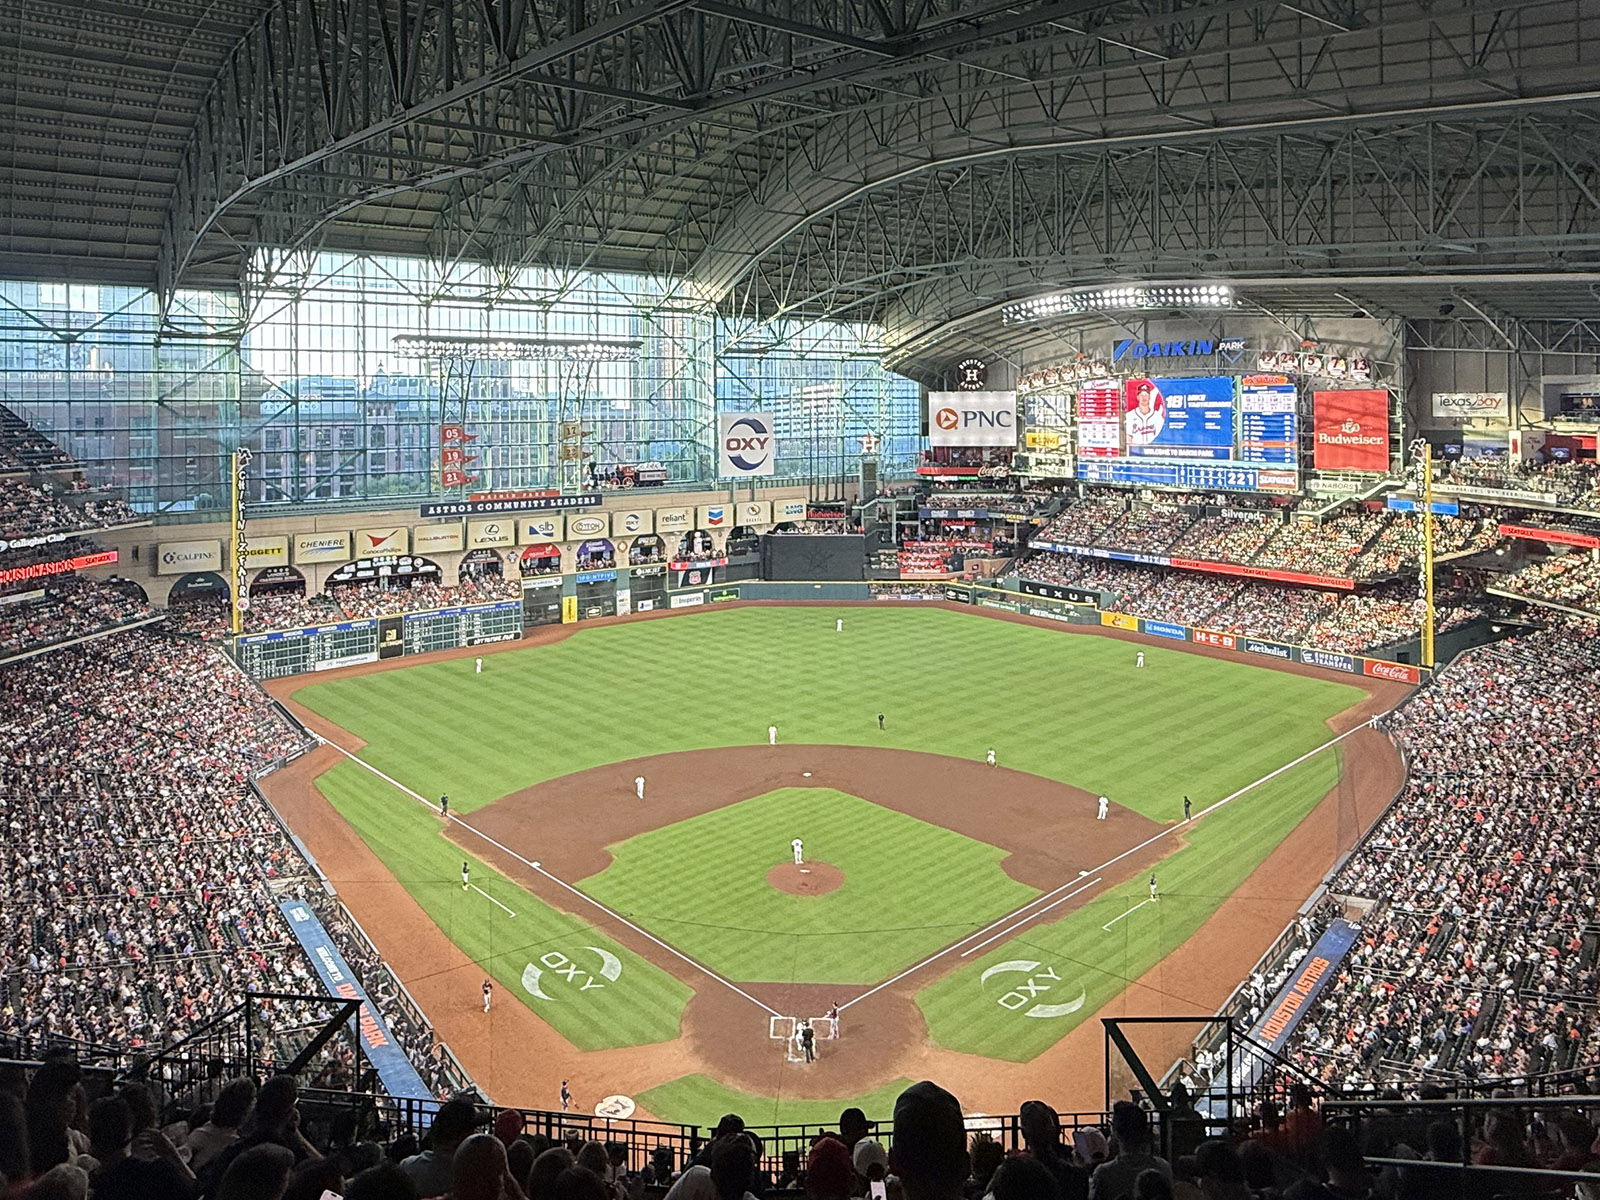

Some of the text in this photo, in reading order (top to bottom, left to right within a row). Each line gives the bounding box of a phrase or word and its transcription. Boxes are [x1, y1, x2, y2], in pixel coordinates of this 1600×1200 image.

[1132, 340, 1245, 358] DAIKIN PARK
[1281, 353, 1295, 363] 24
[1307, 355, 1315, 365] 5
[1331, 357, 1339, 368] 7
[958, 359, 985, 369] HOUSTON
[1353, 359, 1367, 370] 13
[1438, 395, 1502, 410] Texas Bay
[962, 411, 1011, 427] PNC
[446, 429, 458, 438] 05
[566, 427, 576, 435] 17
[726, 437, 769, 451] OXY
[446, 452, 458, 461] 19
[446, 472, 458, 481] 21
[428, 497, 596, 514] ASTROS COMMUNITY LEADERS
[1151, 503, 1178, 515] Chevy
[662, 514, 686, 522] reliant
[539, 522, 554, 532] slb
[9, 533, 66, 549] Gallagher Club
[300, 539, 345, 549] CHENIERE
[177, 553, 214, 561] CALPINE
[1025, 585, 1094, 603] LEXUS
[1153, 625, 1185, 636] HONDA
[1248, 645, 1288, 657] Methodist
[1315, 652, 1345, 662] ENERGY
[1315, 658, 1352, 670] TRANSFER
[540, 951, 605, 990] OXY
[997, 966, 1063, 1010] OXY
[1259, 956, 1330, 1042] HOUSTON ASTROS
[360, 1016, 389, 1049] PARK
